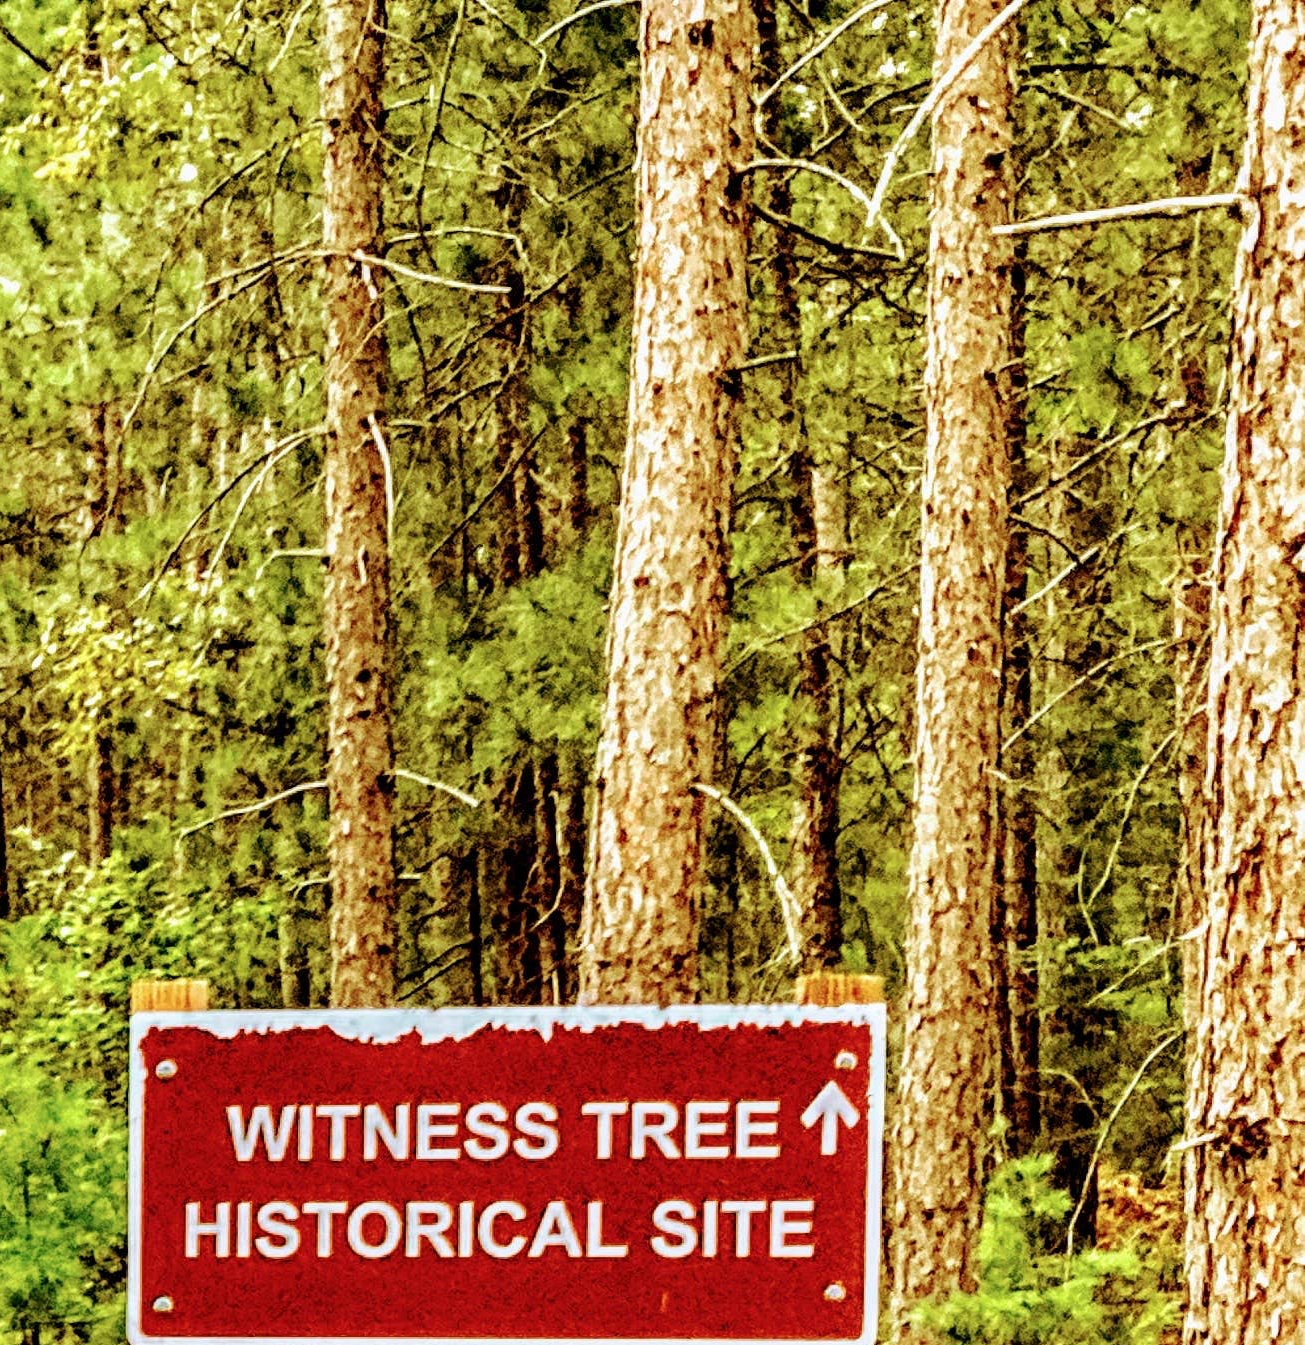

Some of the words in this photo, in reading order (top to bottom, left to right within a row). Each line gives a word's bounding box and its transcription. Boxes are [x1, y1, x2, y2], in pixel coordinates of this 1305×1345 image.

[225, 1101, 560, 1162] WITNESS
[580, 1099, 781, 1160] TREE
[183, 1199, 630, 1260] HISTORICAL
[649, 1199, 816, 1260] SITE
